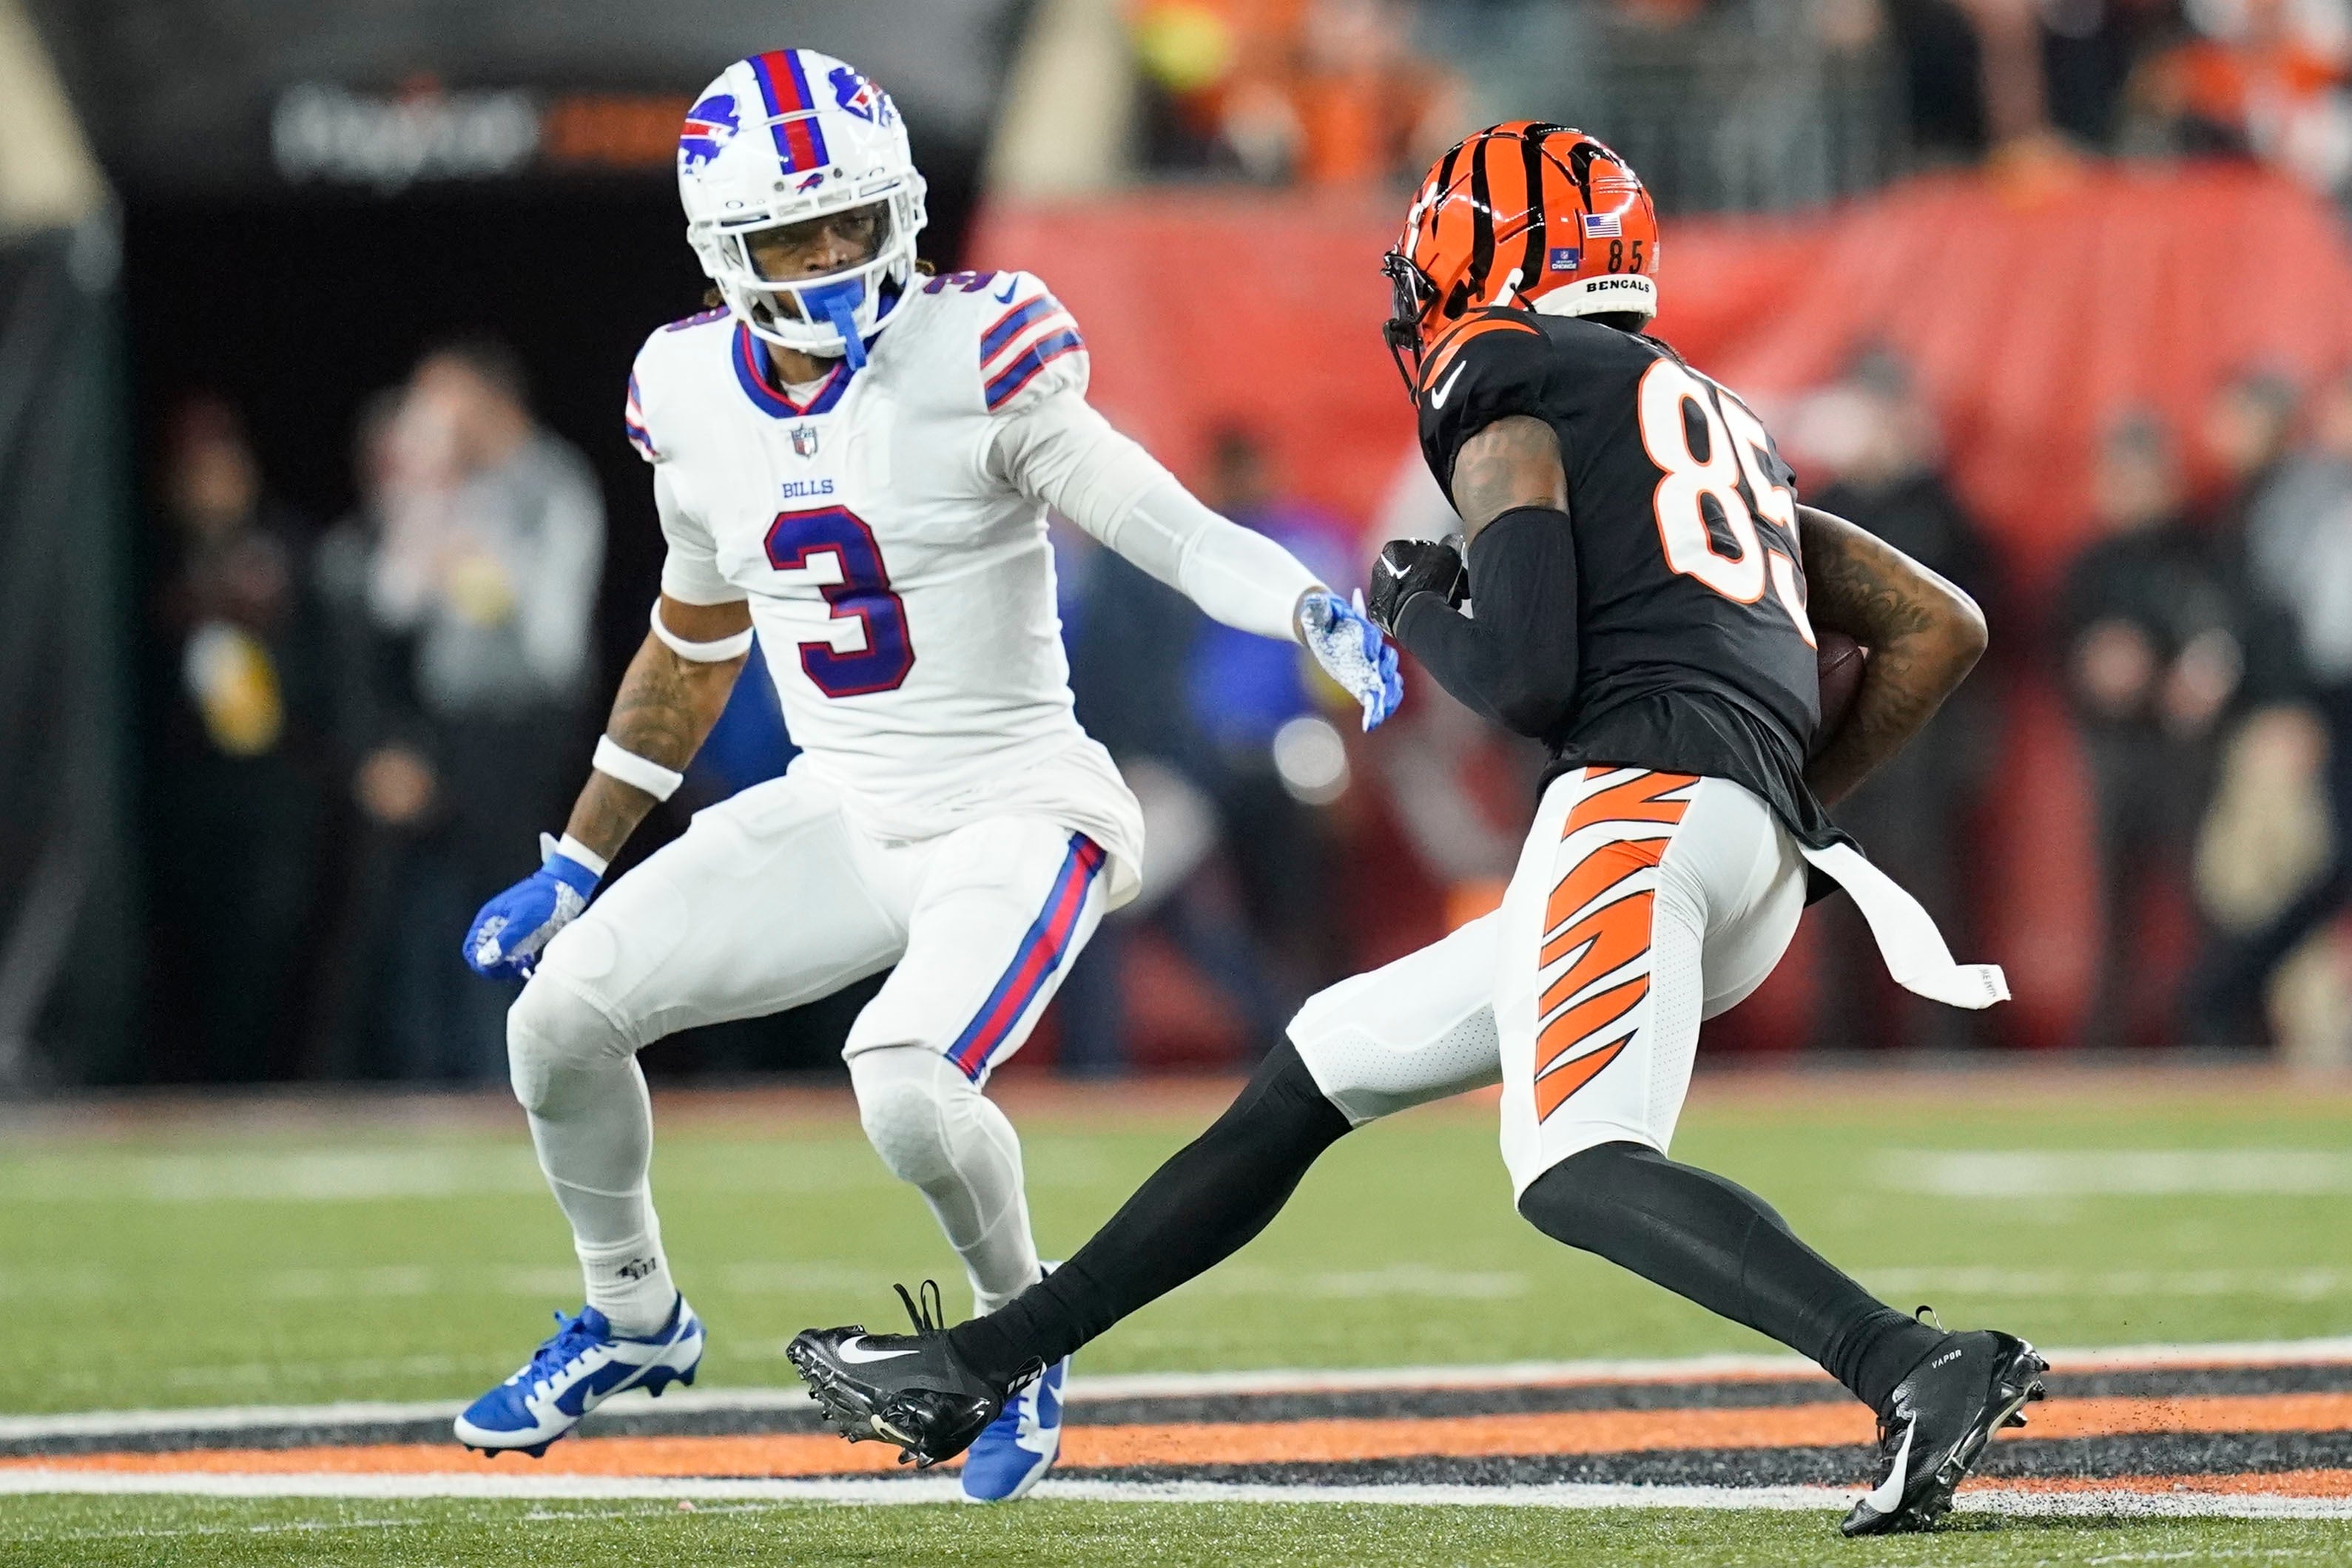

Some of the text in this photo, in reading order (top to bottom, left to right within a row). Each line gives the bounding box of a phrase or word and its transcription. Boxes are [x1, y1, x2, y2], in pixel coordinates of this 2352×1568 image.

[1608, 239, 1643, 274] 85
[1586, 280, 1650, 293] BENGALS
[782, 479, 834, 499] BILLS
[1637, 356, 1818, 650] 85
[764, 504, 916, 699] 3
[1932, 1349, 1961, 1369] VAPOR
